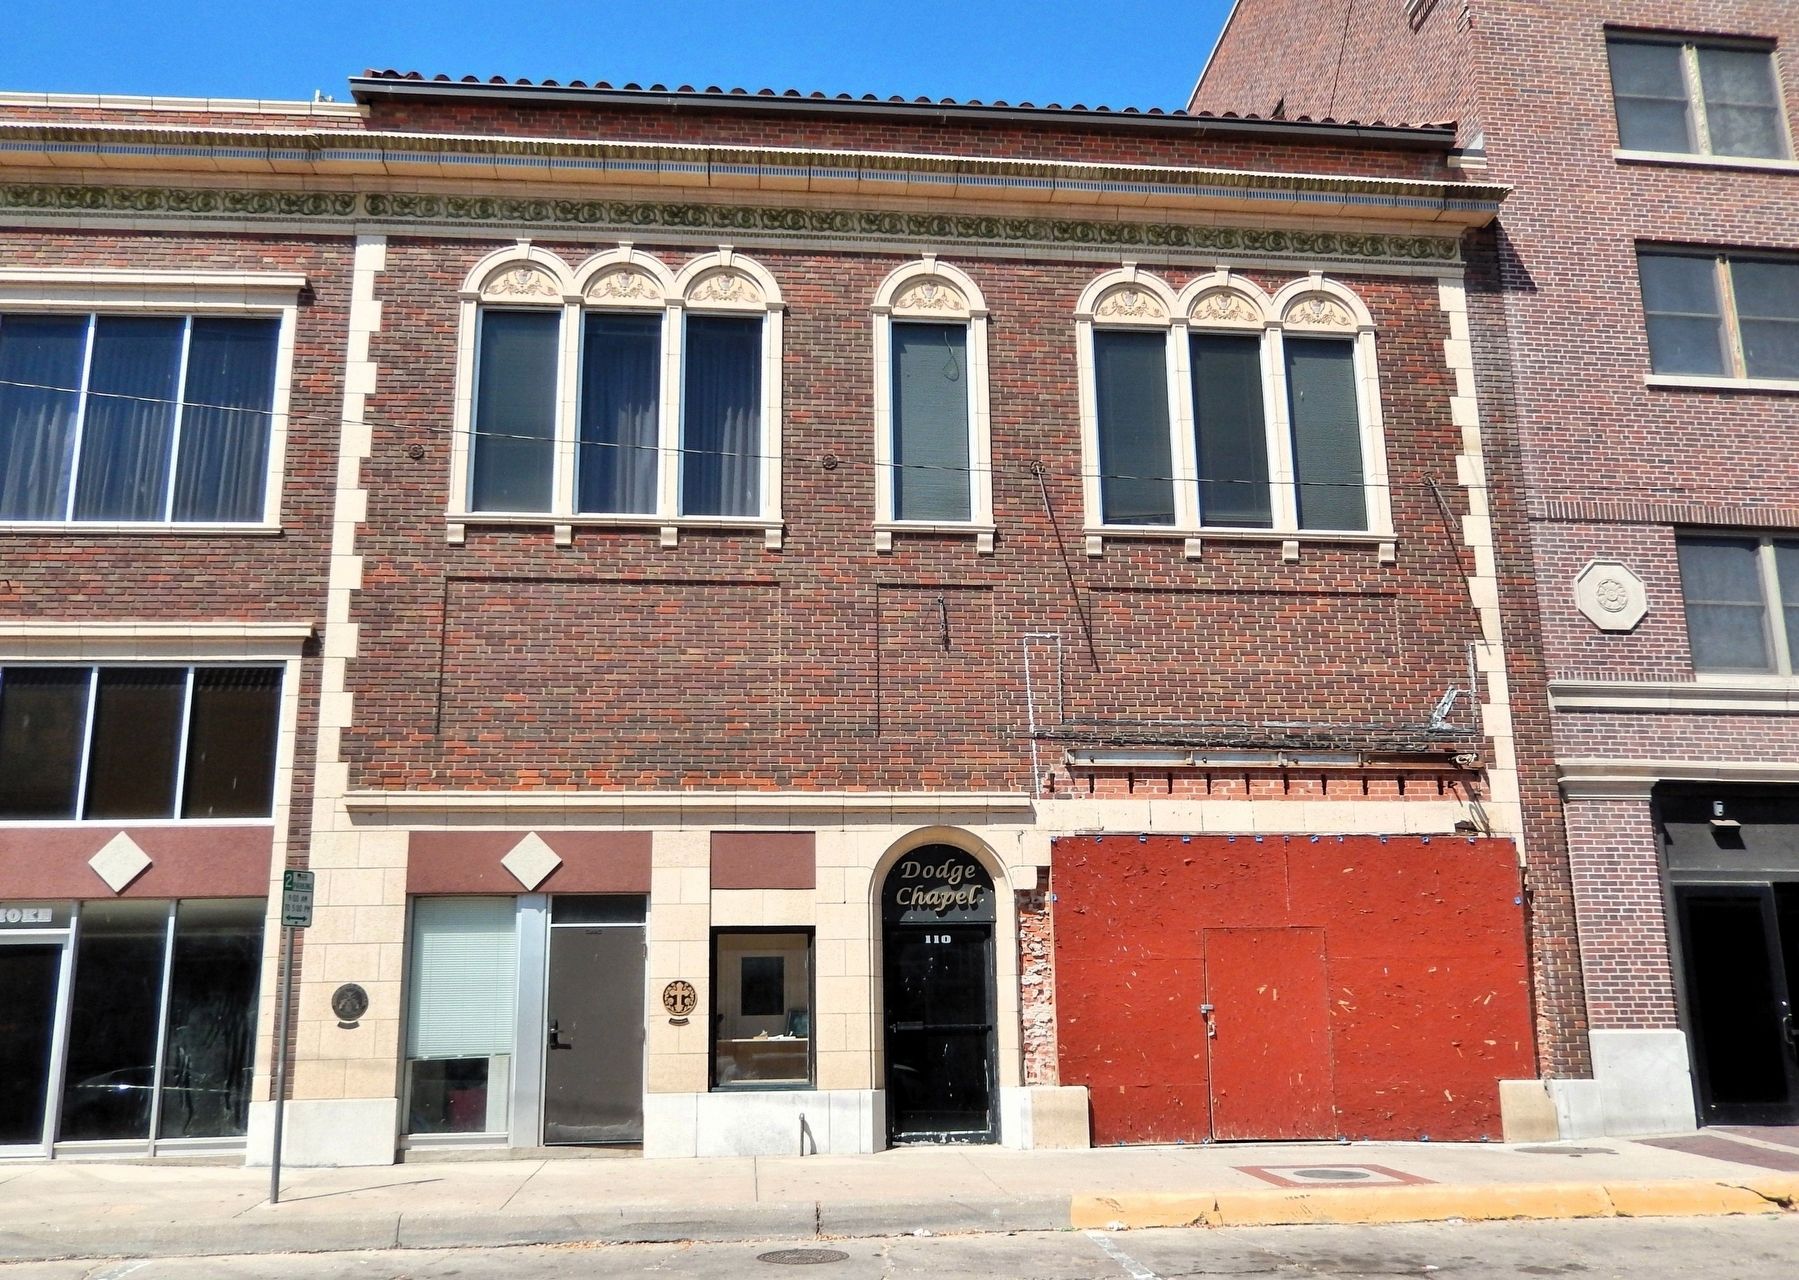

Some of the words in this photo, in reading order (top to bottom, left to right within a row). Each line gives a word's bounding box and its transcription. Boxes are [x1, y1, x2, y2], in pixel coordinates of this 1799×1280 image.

[285, 873, 293, 887] 2
[901, 858, 976, 885] Dodge
[896, 885, 982, 912] Chapel
[925, 935, 952, 944] 110
